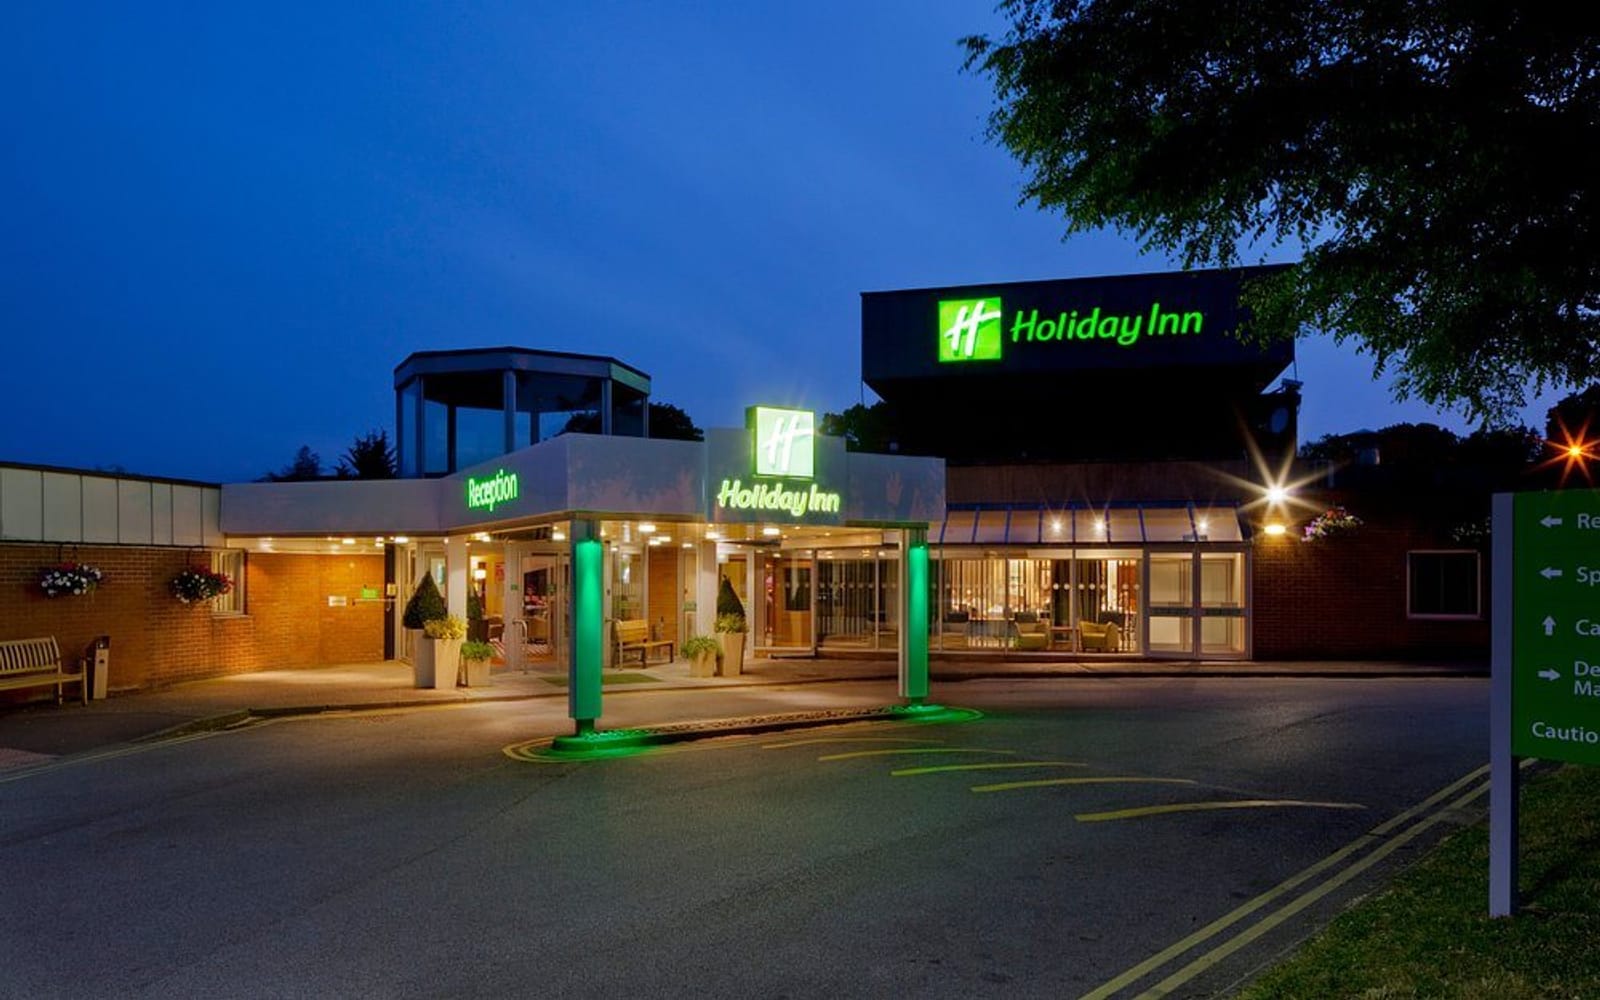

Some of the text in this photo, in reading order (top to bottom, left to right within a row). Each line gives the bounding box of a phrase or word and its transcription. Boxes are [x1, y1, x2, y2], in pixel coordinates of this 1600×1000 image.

[1010, 303, 1203, 346] Holiday Inn
[468, 469, 518, 512] Reception
[717, 479, 840, 517] Holiday Inn
[1531, 721, 1599, 744] Cautio
